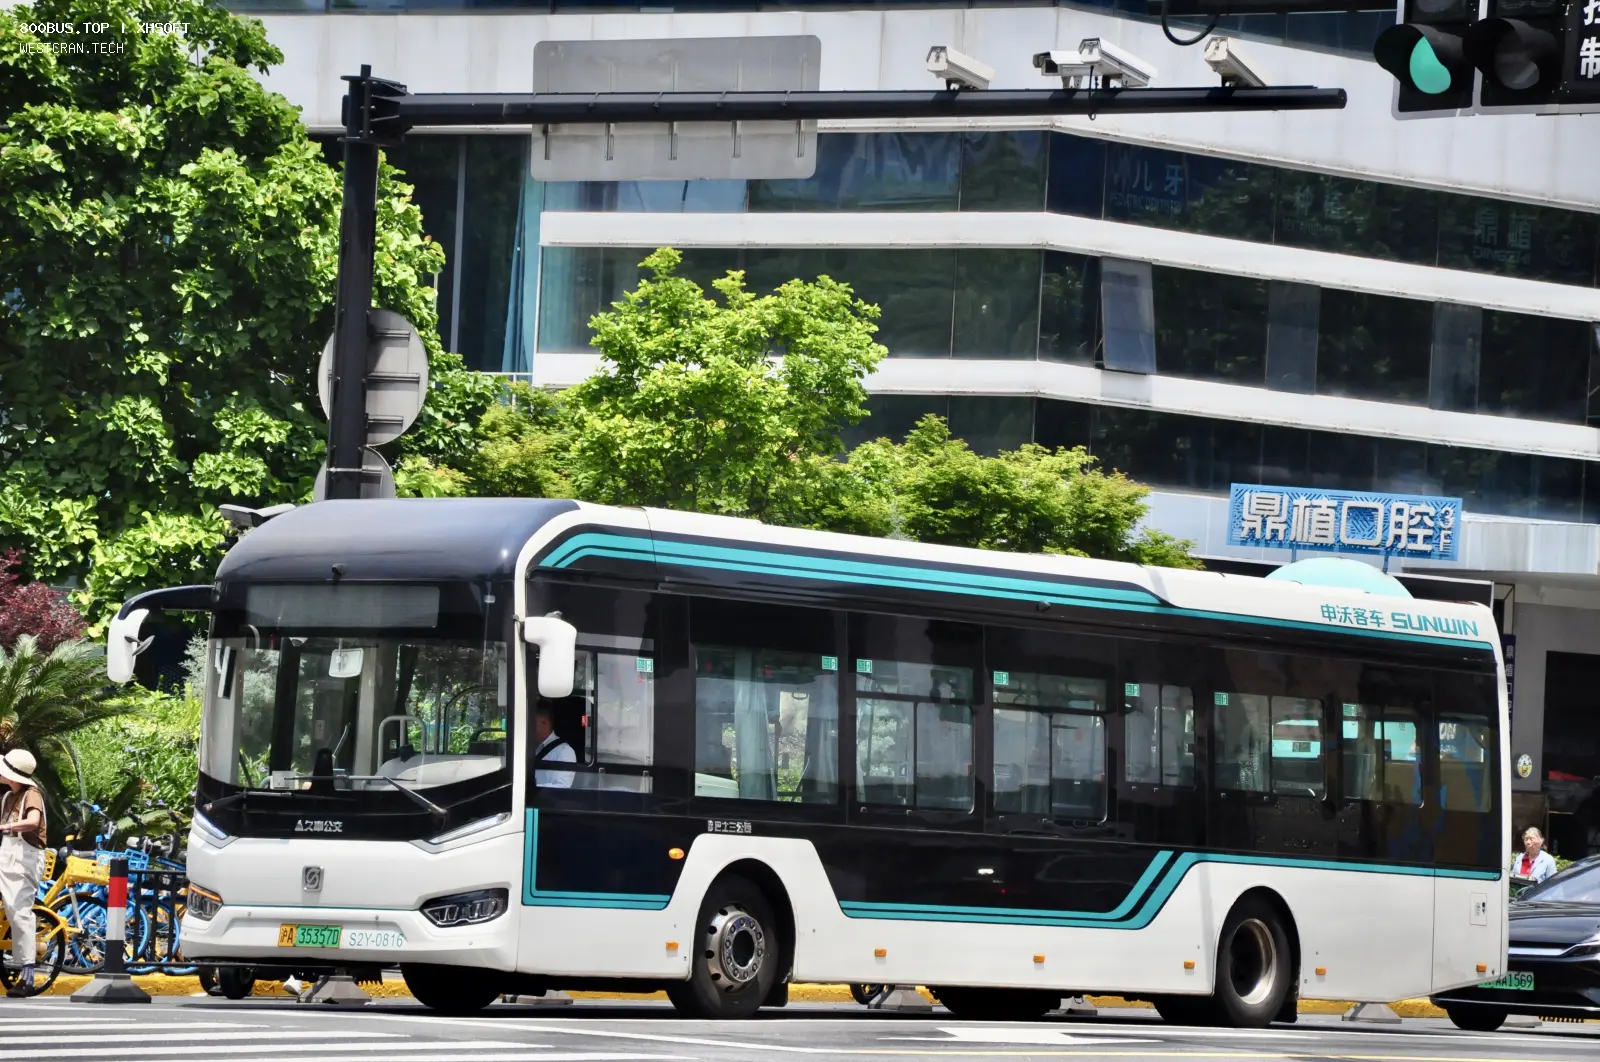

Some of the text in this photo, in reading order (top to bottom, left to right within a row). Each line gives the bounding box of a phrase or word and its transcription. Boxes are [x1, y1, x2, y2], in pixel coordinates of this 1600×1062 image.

[1240, 492, 1434, 552] 鼎植口腔
[1320, 604, 1385, 628] 申沃客车
[1391, 612, 1479, 637] SUNWIN
[348, 932, 403, 947] S2Y-0816
[1485, 973, 1533, 987] AA1569
